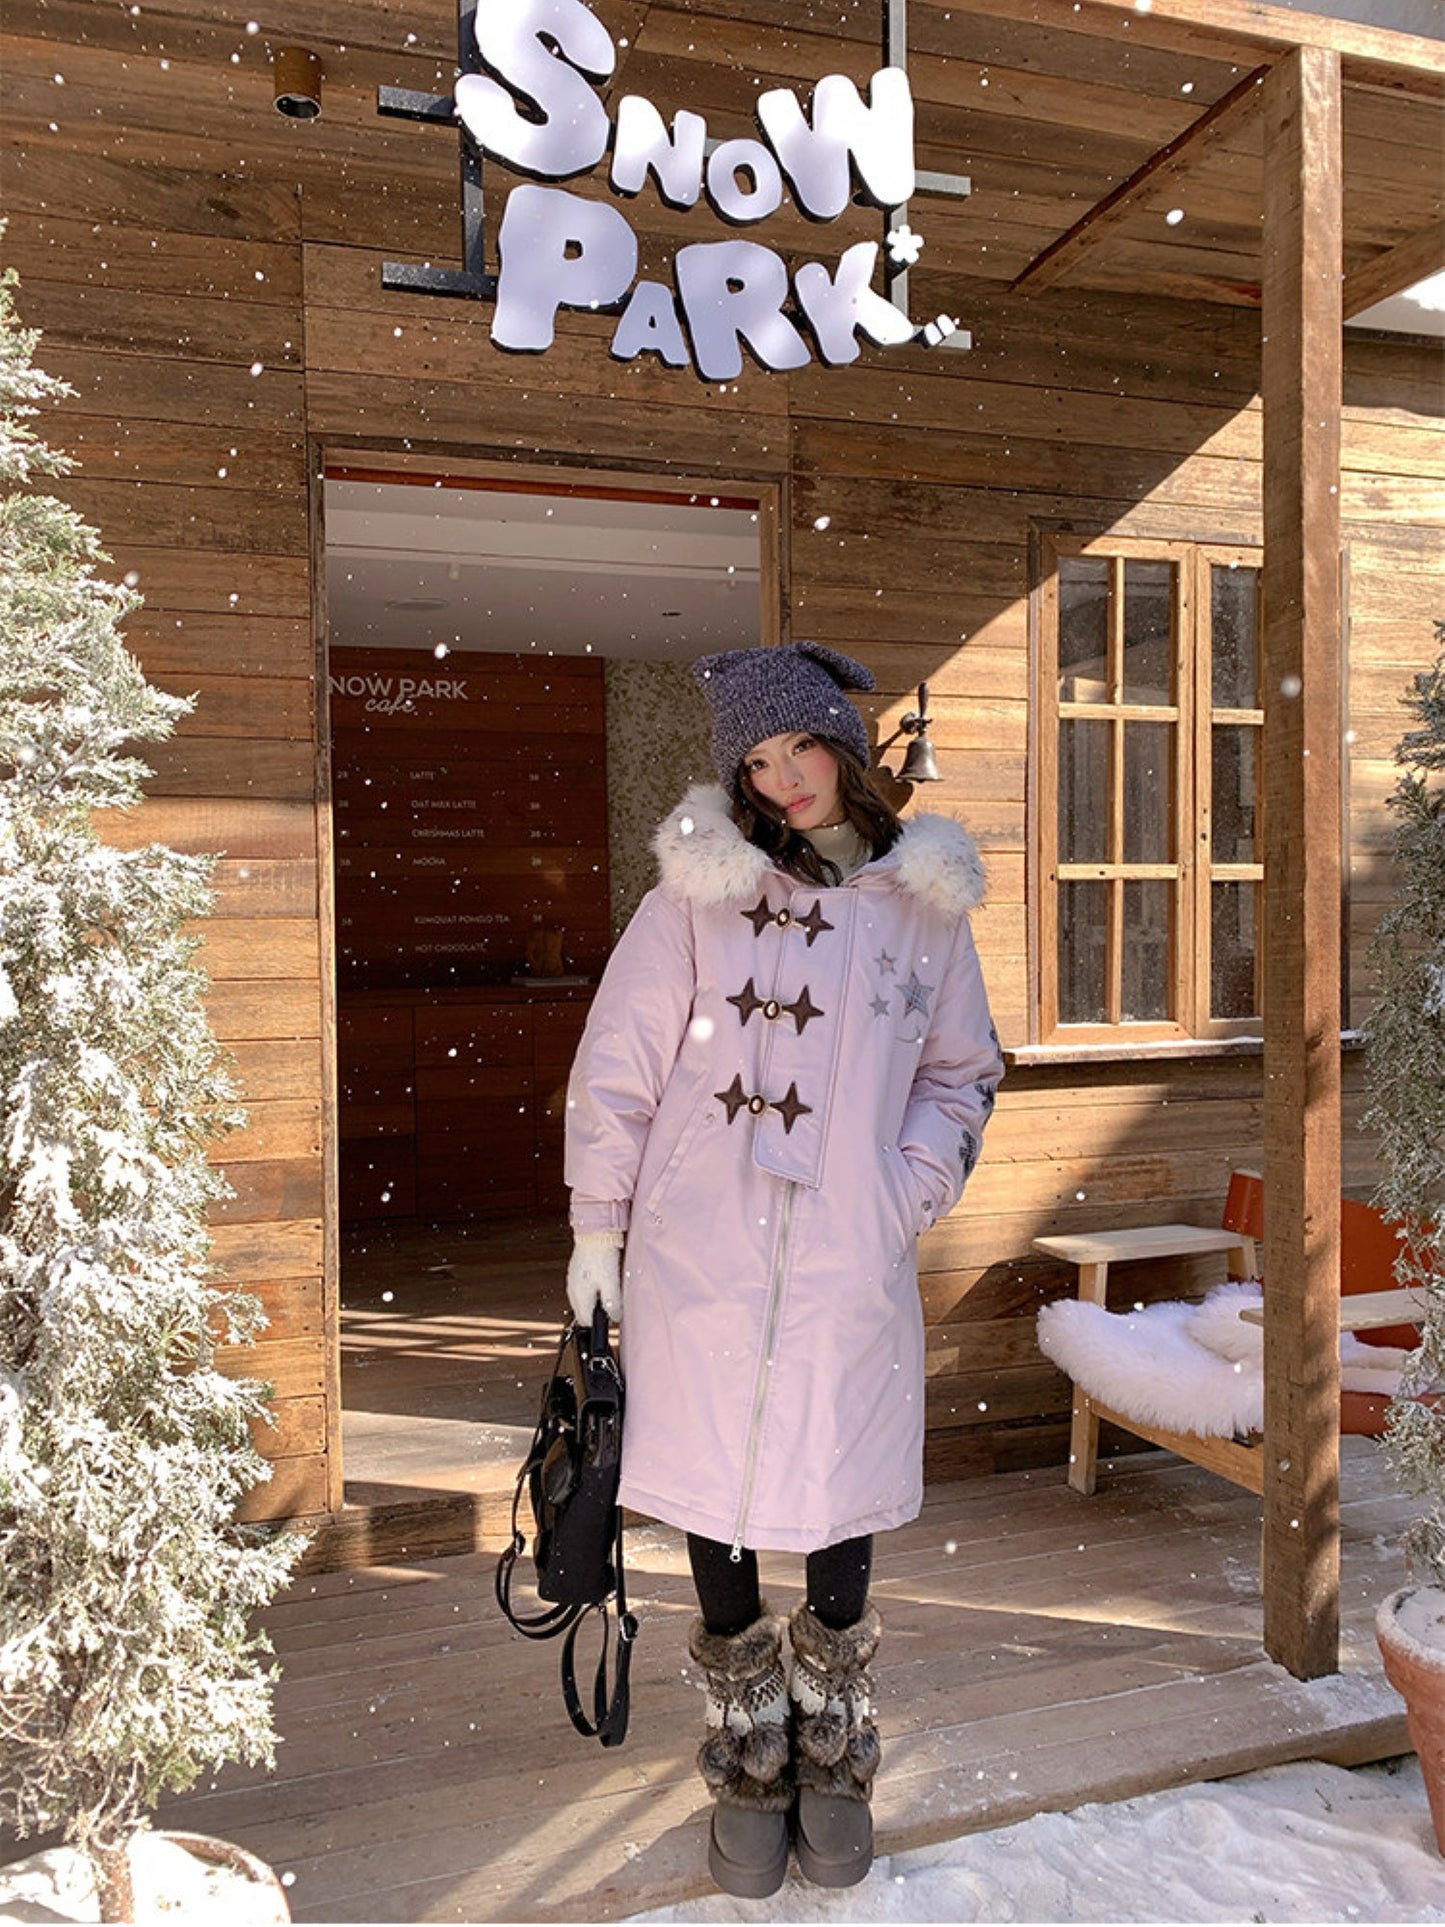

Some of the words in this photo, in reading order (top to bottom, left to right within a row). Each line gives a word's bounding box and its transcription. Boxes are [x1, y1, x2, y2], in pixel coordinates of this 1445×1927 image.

[455, 0, 915, 222] SNOW
[491, 184, 914, 381] PARK
[329, 675, 393, 697] NOW
[399, 678, 469, 700] PARK
[452, 799, 477, 809] LATTE
[461, 828, 485, 838] LATTE
